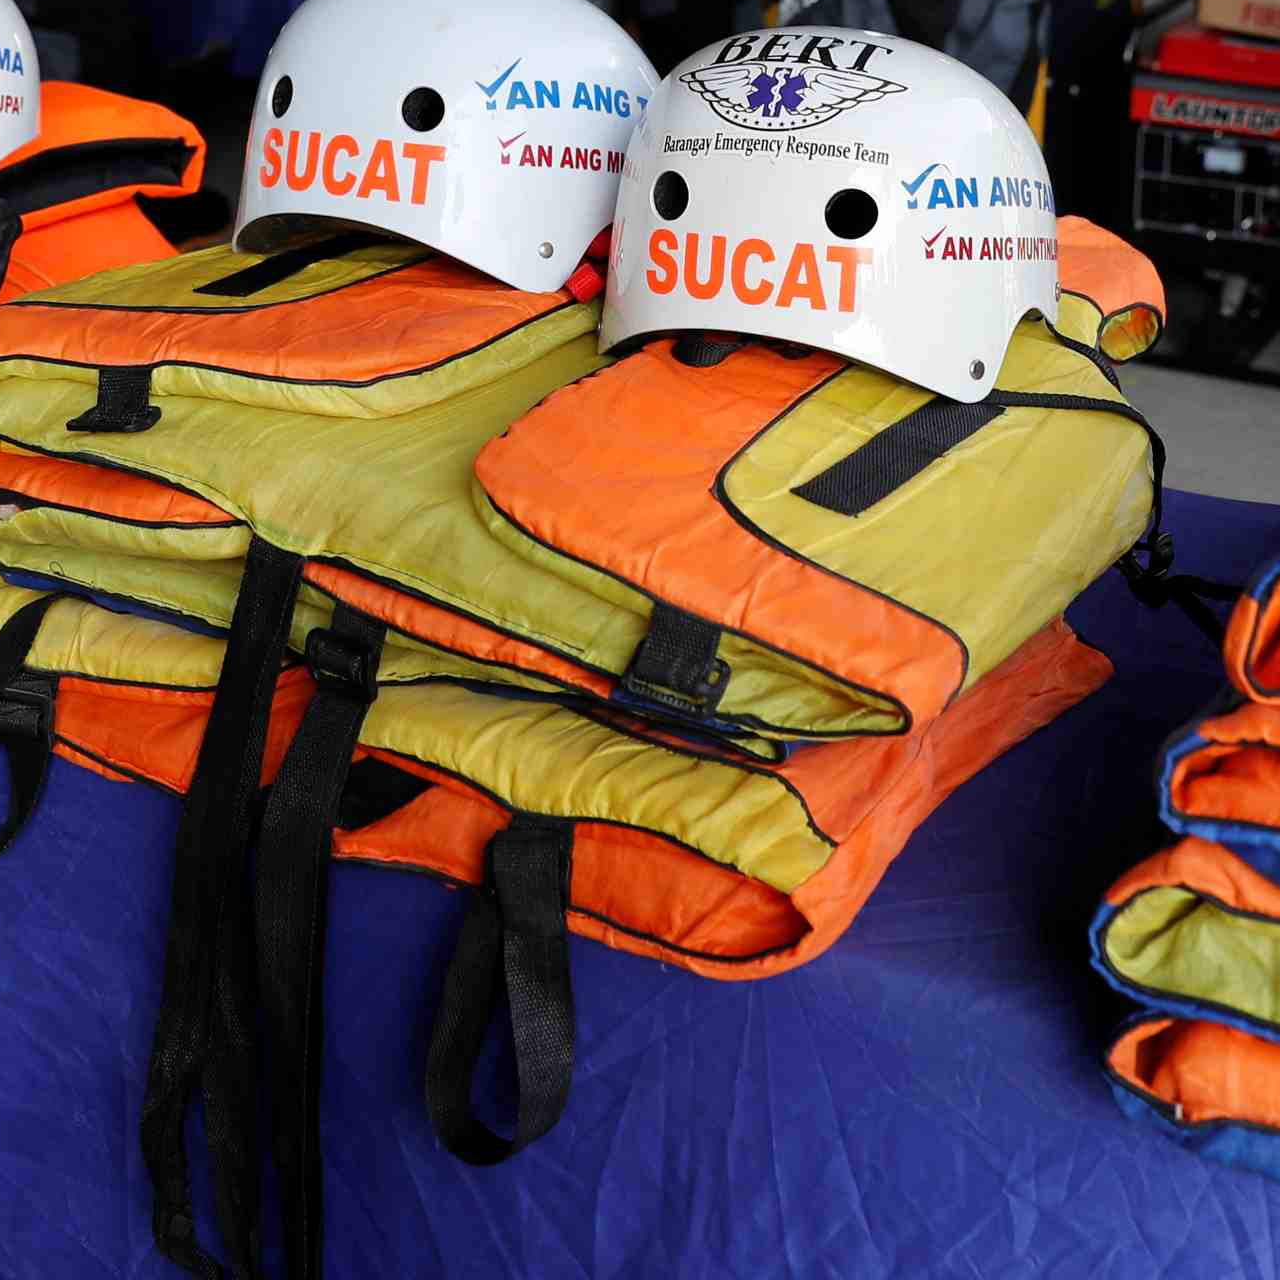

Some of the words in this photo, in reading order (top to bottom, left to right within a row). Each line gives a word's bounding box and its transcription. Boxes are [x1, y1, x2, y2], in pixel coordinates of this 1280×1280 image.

[710, 33, 895, 73] BERT
[572, 81, 631, 118] ANG
[259, 127, 447, 206] SUCAT
[560, 148, 603, 173] ANG
[663, 134, 713, 157] Barangay
[714, 133, 784, 157] Emergency
[786, 135, 851, 164] Response
[853, 142, 890, 166] Team
[990, 176, 1032, 209] ANG
[979, 236, 1014, 261] ANG
[646, 228, 874, 313] SUCAT
